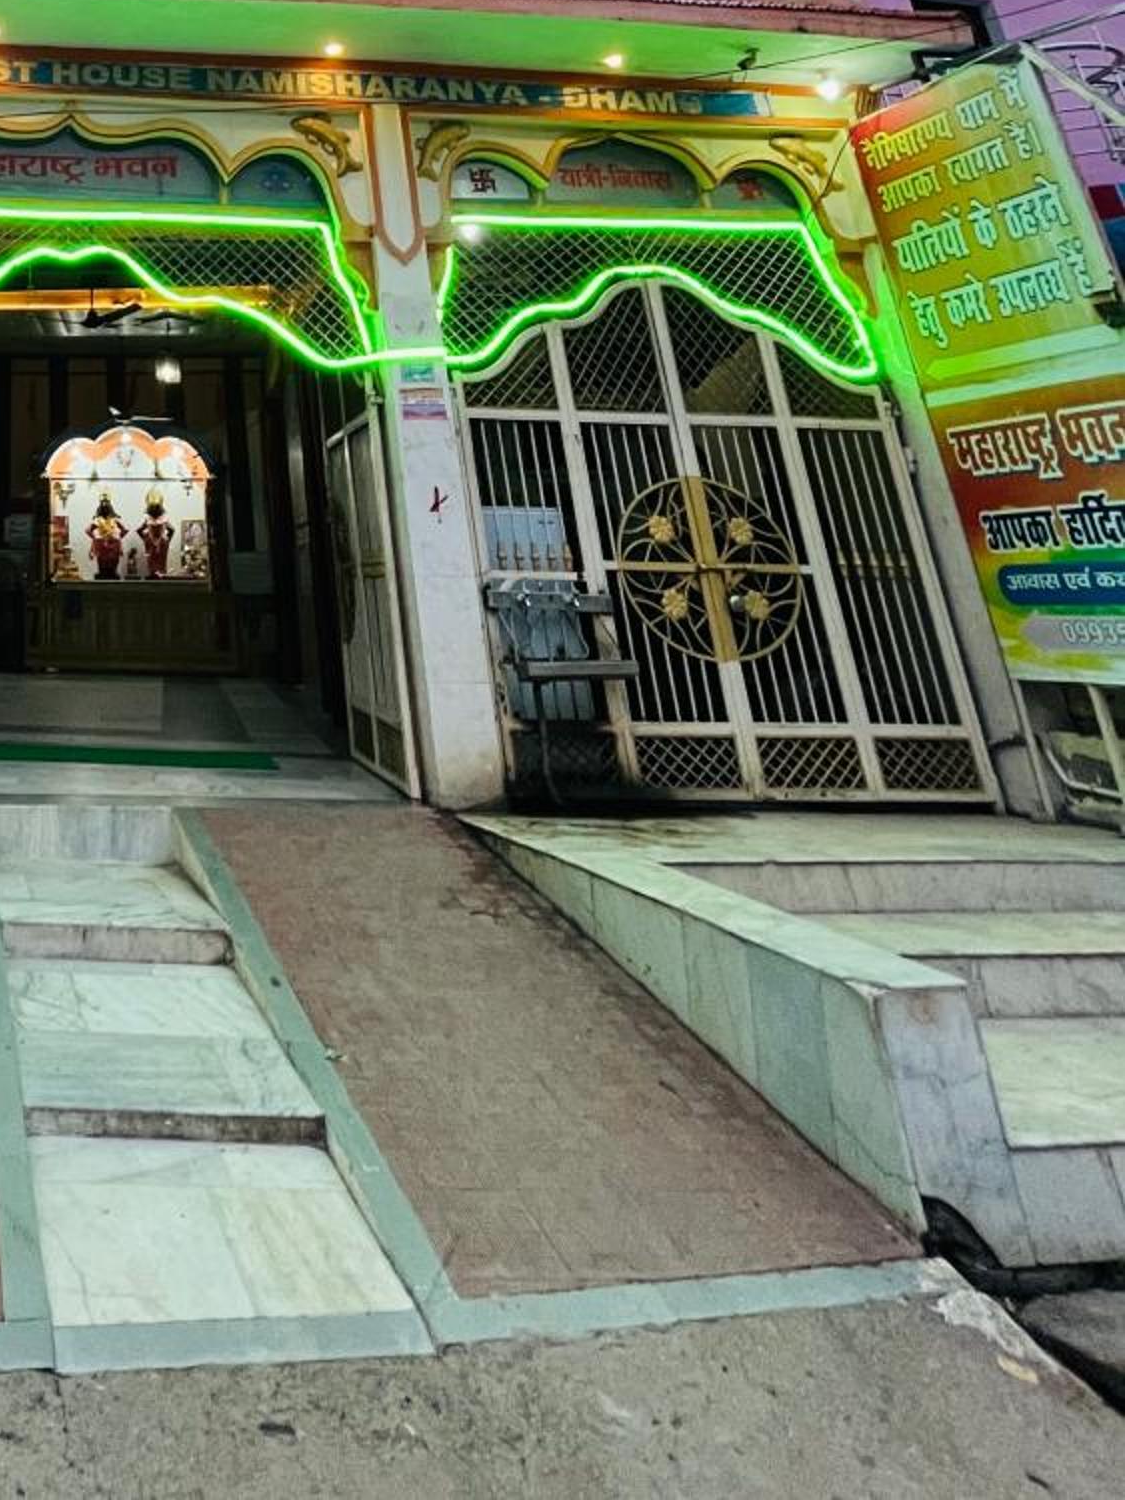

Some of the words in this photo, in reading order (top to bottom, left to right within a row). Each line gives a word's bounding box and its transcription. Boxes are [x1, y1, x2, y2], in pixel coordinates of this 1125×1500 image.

[52, 61, 189, 89] HOUSE
[206, 68, 527, 106] NAMISHARANYA
[998, 66, 1027, 108] में
[92, 155, 179, 179] भवन
[877, 165, 942, 213] आपका
[967, 198, 998, 249] के
[906, 290, 949, 348] हेतु
[940, 272, 993, 327] कमरे
[978, 506, 1063, 552] आपका
[1006, 573, 1060, 591] आवास
[1062, 566, 1092, 590] एवं
